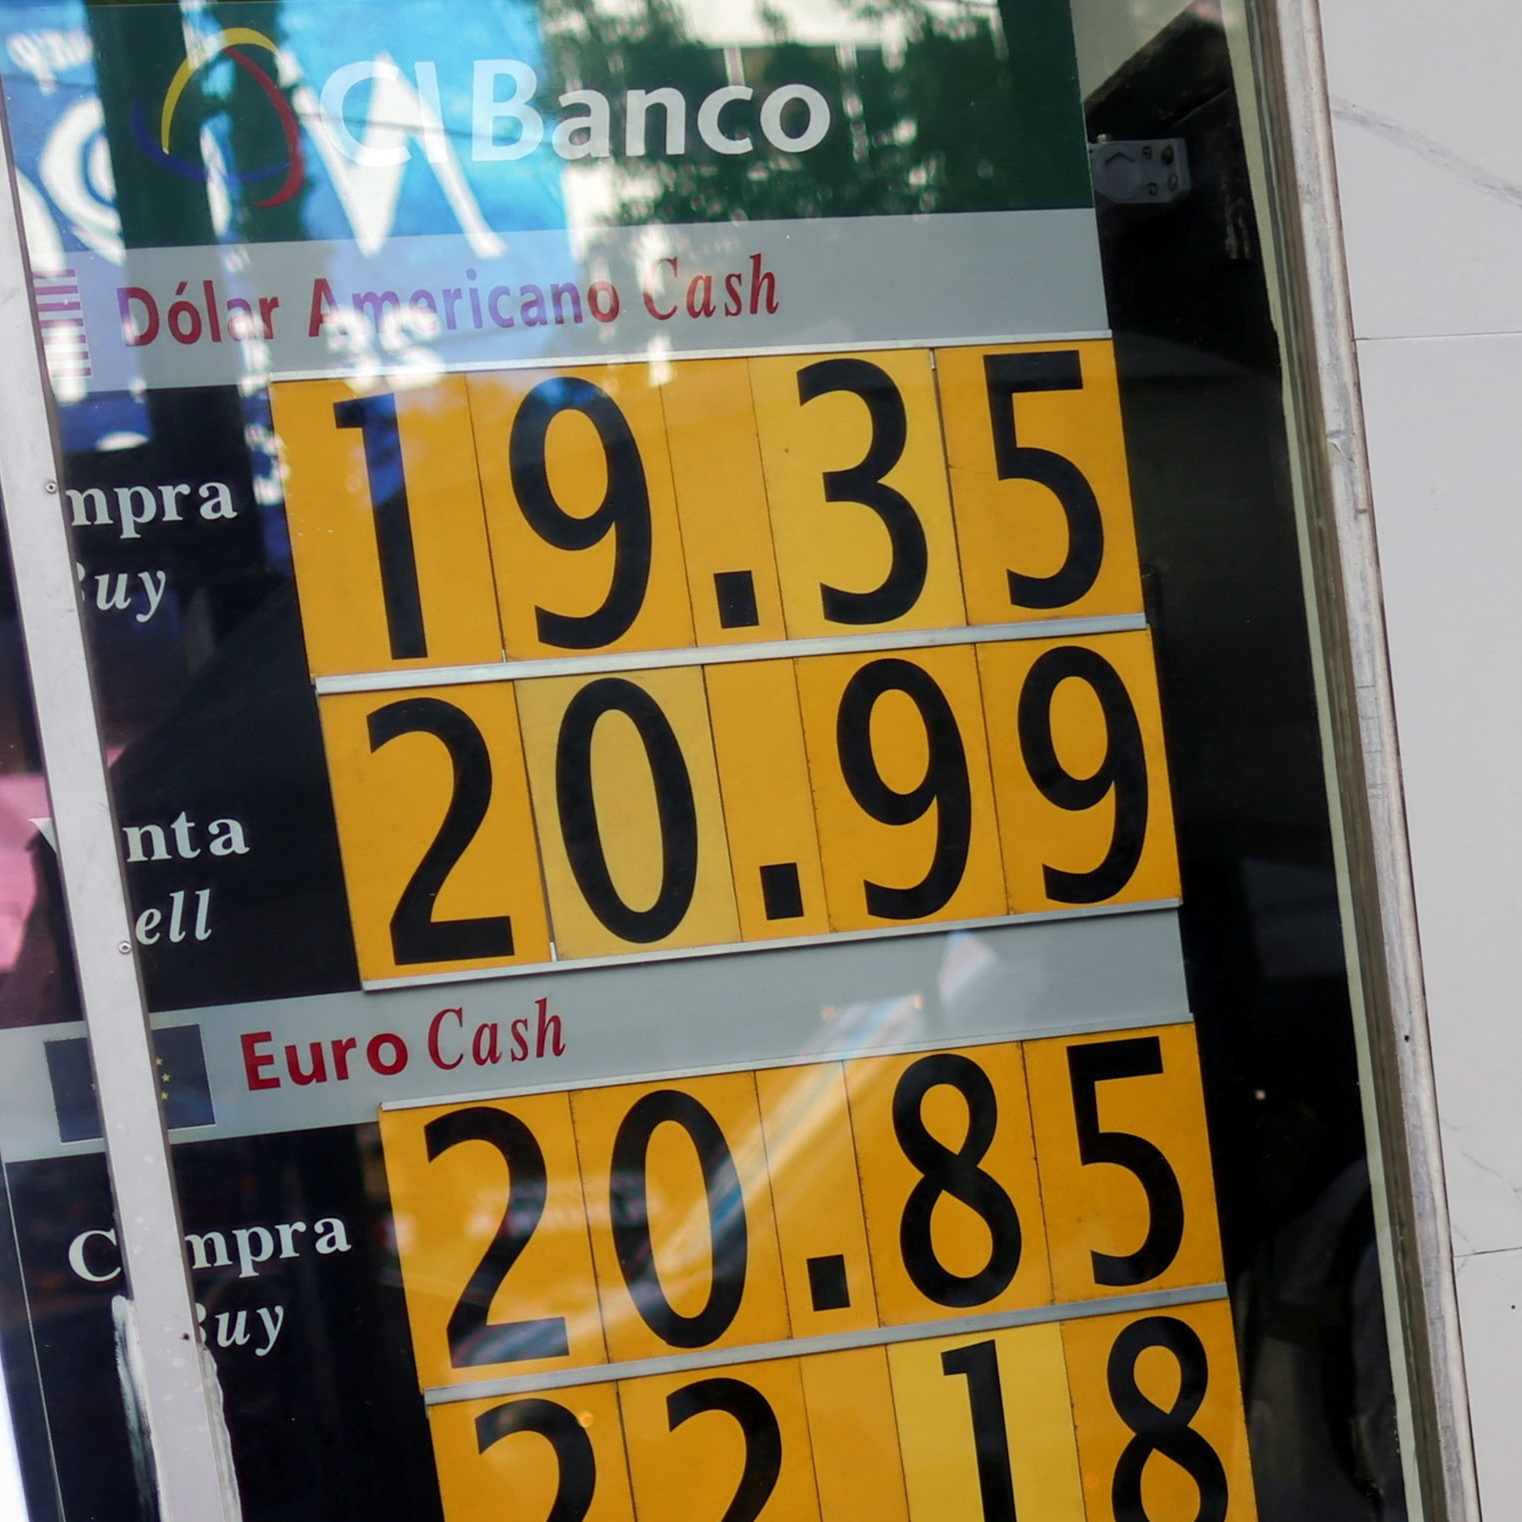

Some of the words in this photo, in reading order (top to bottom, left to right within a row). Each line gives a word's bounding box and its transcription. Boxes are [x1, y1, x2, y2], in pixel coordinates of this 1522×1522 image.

[116, 280, 279, 347] Dólar
[308, 267, 621, 338] Americano
[642, 253, 779, 322] Cash
[332, 349, 1105, 660] 19.35
[28, 810, 251, 863] nta
[365, 644, 1149, 965] 20.99
[134, 888, 213, 946] ell
[240, 1030, 408, 1091] Euro
[427, 997, 567, 1071] Cash
[68, 1215, 352, 1283] Cmpra
[423, 1035, 1186, 1371] 20.85
